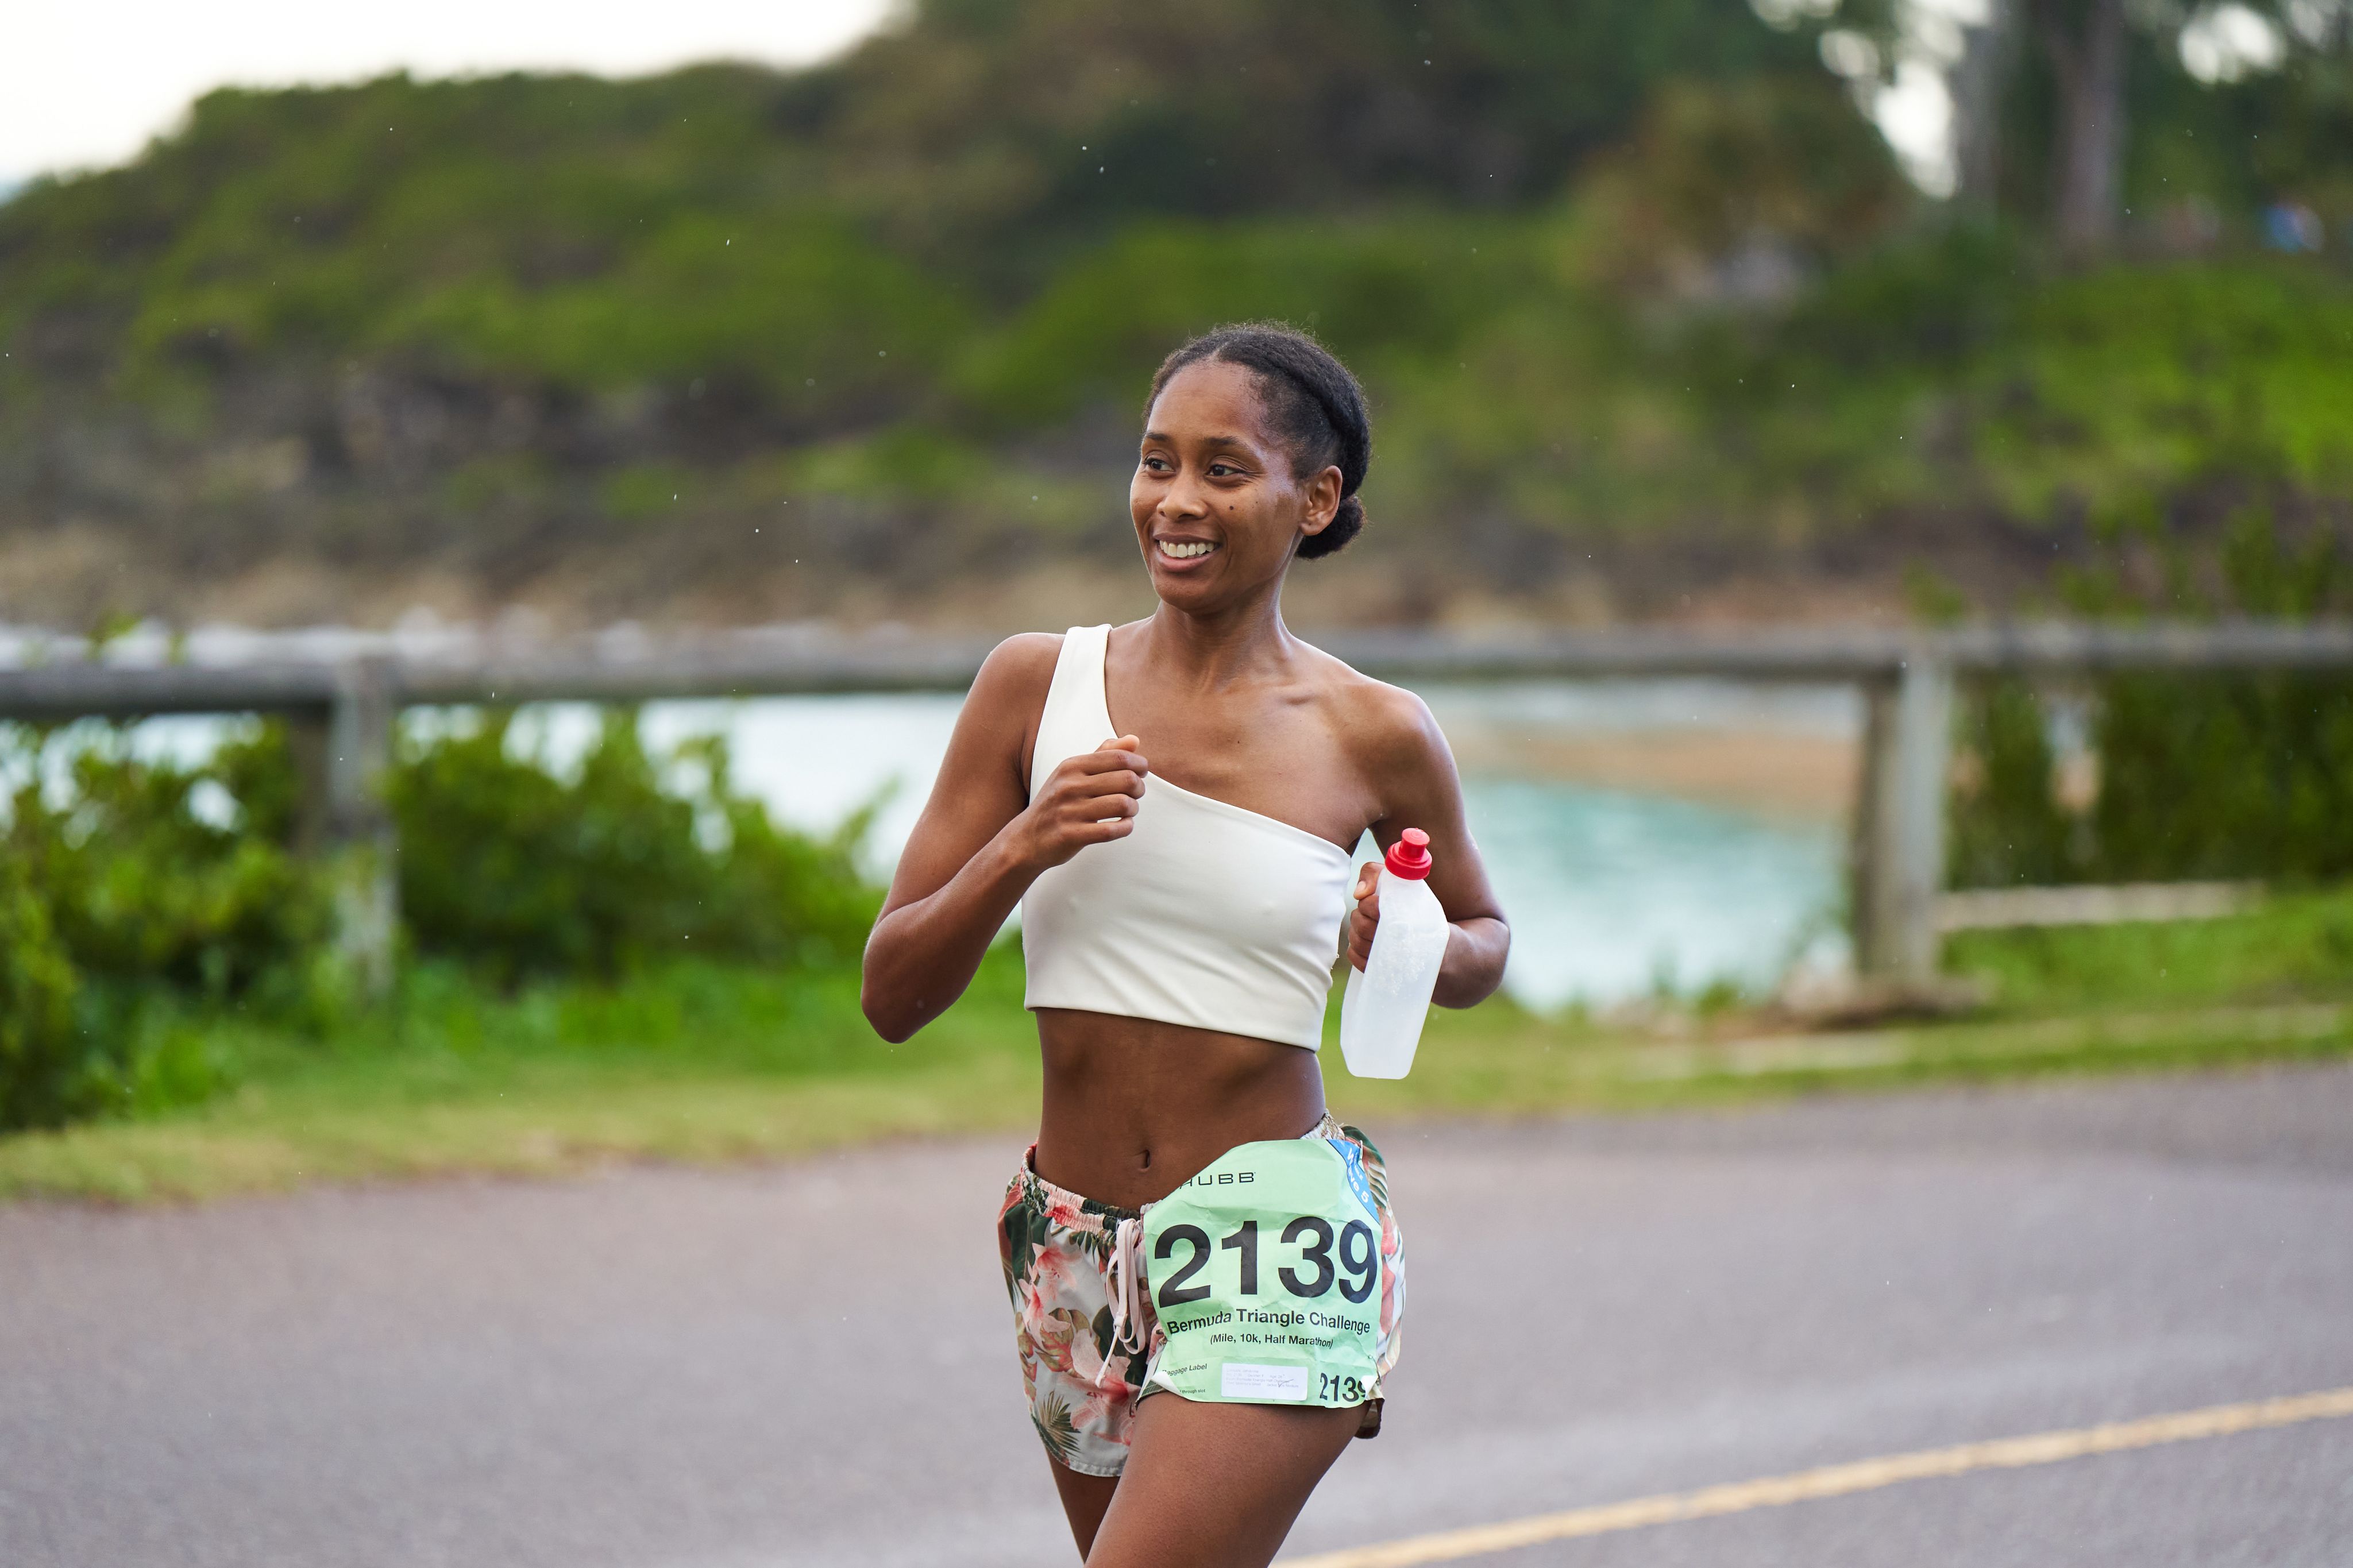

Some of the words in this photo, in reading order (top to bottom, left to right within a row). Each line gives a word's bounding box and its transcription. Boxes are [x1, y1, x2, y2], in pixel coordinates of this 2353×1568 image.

[1361, 1191, 1369, 1203] 5
[1154, 1216, 1378, 1308] 2139
[1167, 1311, 1232, 1335] Bermuda
[1236, 1308, 1305, 1327] Triangle
[1309, 1312, 1371, 1335] Challenge
[1210, 1334, 1236, 1345] (Mile,
[1240, 1334, 1262, 1344] 10k,
[1265, 1334, 1286, 1344] Half
[1289, 1335, 1333, 1349] Marathon)
[1162, 1367, 1187, 1376] aggage
[1189, 1363, 1208, 1371] Label
